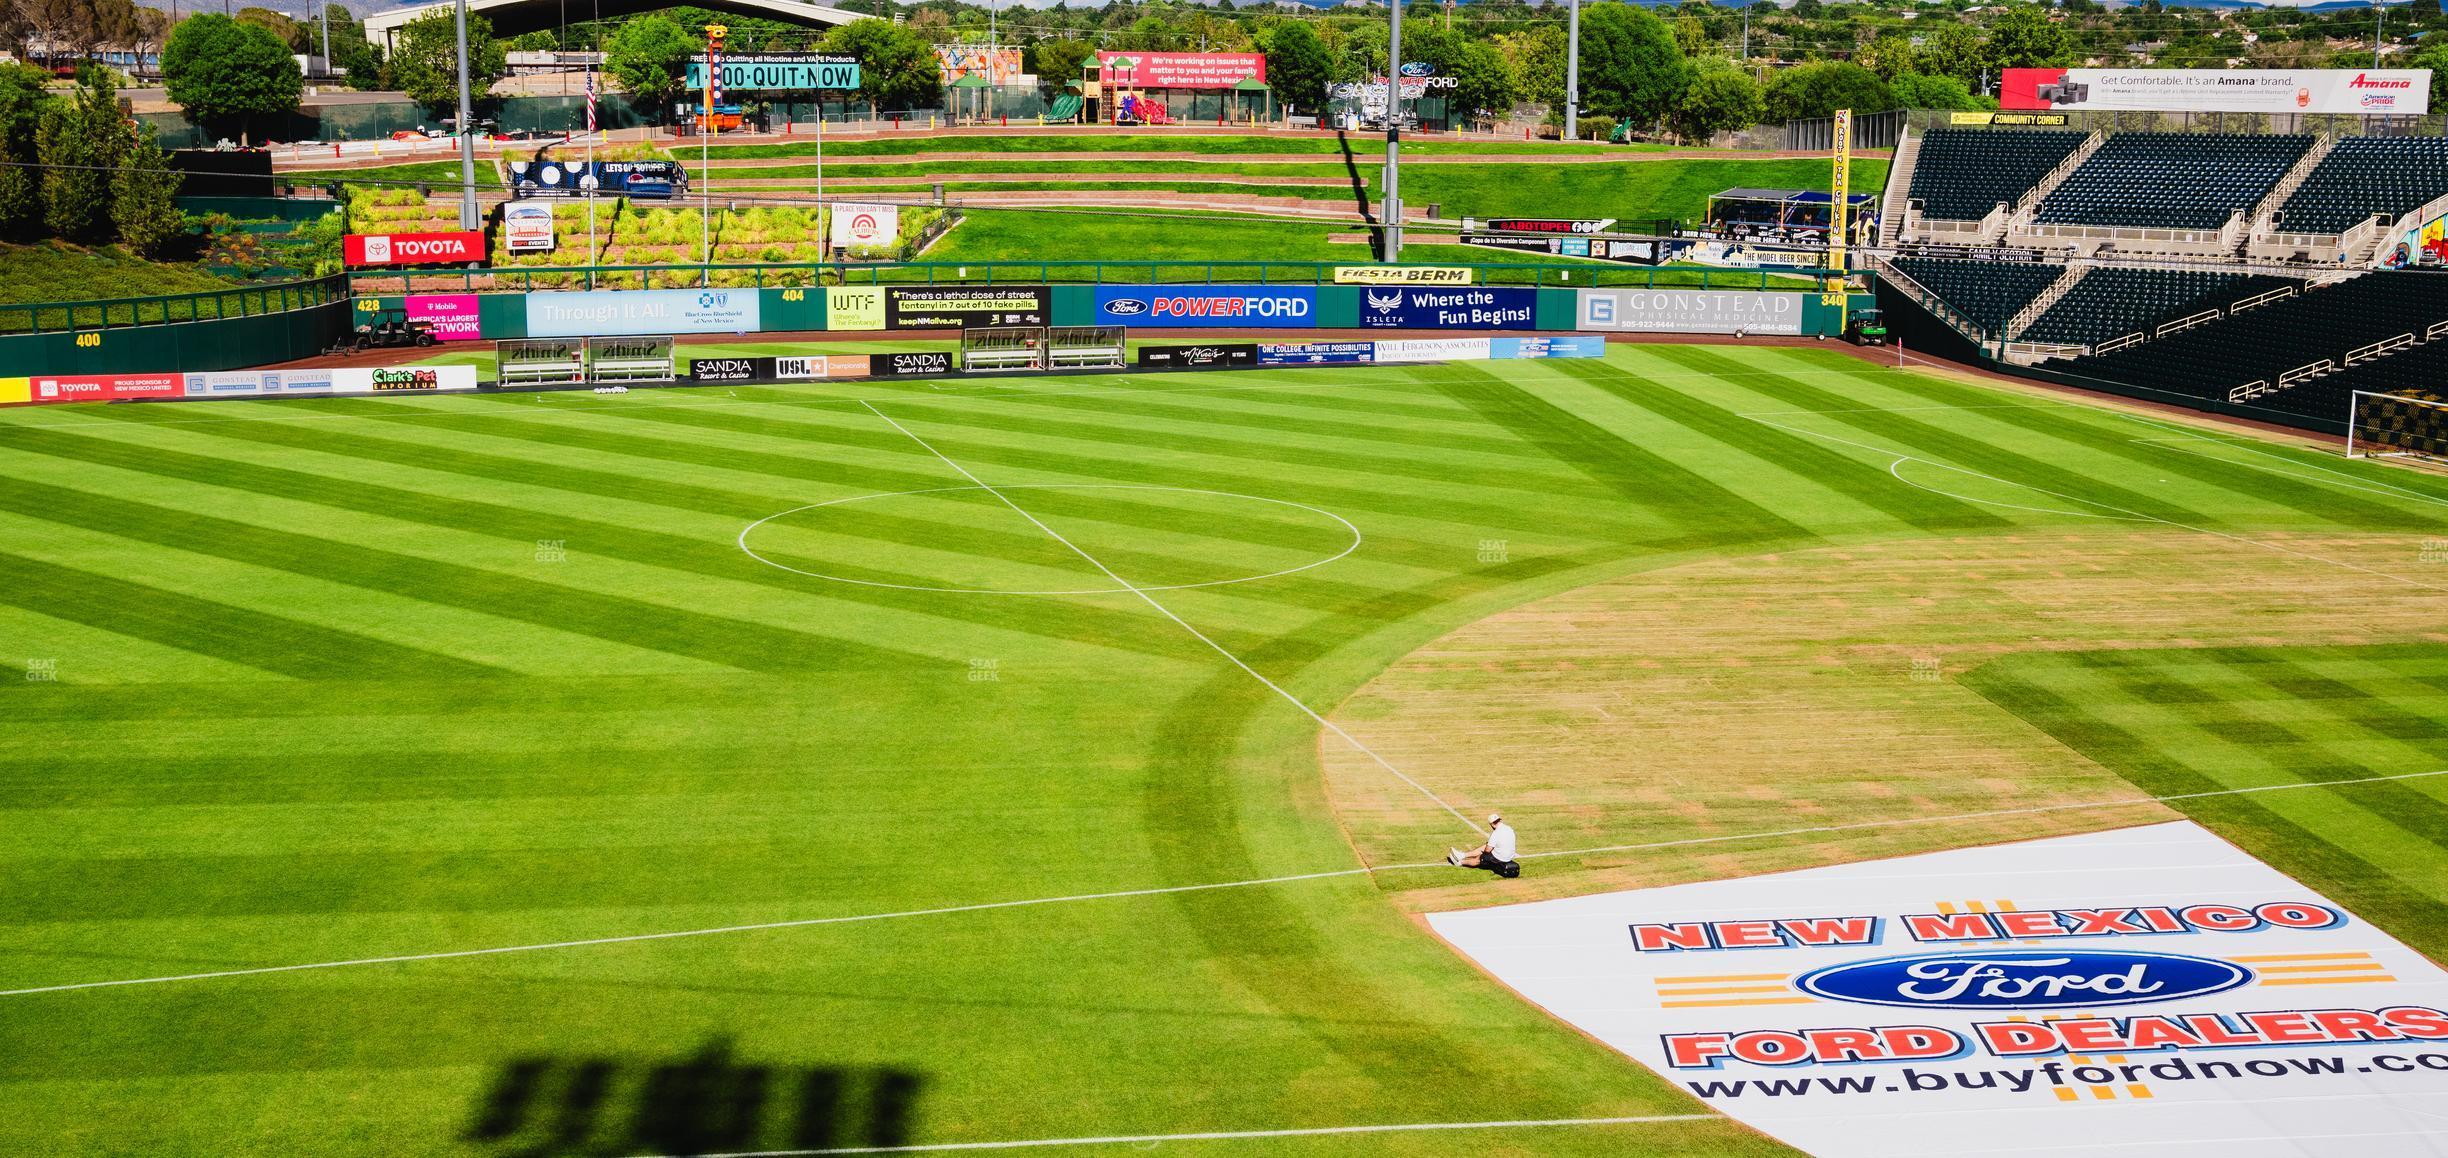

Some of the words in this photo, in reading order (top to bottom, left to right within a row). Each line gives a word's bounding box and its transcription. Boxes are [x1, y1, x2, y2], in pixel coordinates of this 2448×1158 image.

[1152, 57, 1173, 65] We're
[1175, 57, 1205, 66] working
[1217, 57, 1239, 65] issues
[1240, 57, 1256, 65] that
[1234, 67, 1258, 76] family
[1158, 75, 1177, 84] right
[1204, 76, 1220, 84] New
[2101, 76, 2117, 85] Get
[2120, 76, 2183, 86] Comfortable.
[2186, 76, 2201, 85] It's
[2218, 77, 2255, 86] Amana
[2261, 76, 2294, 86] brand.
[2349, 73, 2411, 88] Amana
[1994, 114, 2036, 124] COMMUNITY
[2036, 115, 2065, 125] CORNER
[605, 163, 623, 173] LETS
[1682, 230, 1699, 238] BEER
[1700, 231, 1717, 239] HERE
[1744, 235, 1762, 243] BEER
[395, 240, 466, 256] TOYOTA
[1743, 252, 1756, 261] THE
[1757, 252, 1777, 262] MODEL
[1779, 253, 1795, 263] BEER
[1796, 253, 1815, 263] SINCE
[1342, 269, 1403, 278] FIESTA
[1406, 270, 1465, 281] BERM
[782, 290, 804, 301] 404
[944, 291, 970, 299] lethal
[971, 291, 996, 299] dose
[996, 290, 1006, 299] of
[1007, 291, 1035, 299] street
[1412, 293, 1464, 308] Where
[1467, 291, 1494, 305] the
[1821, 294, 1844, 306] 340
[357, 300, 380, 311] 428
[833, 294, 875, 311] WTF
[901, 301, 938, 310] fentanyl
[939, 301, 947, 309] in
[971, 301, 981, 309] of
[1015, 301, 1036, 310] pills.
[1112, 301, 1139, 314] Ford
[1630, 293, 1790, 313] GONSTEAD
[543, 303, 618, 323] Through
[624, 303, 637, 318] It
[641, 301, 670, 318] All.
[1439, 310, 1468, 325] Fun
[1471, 306, 1531, 325] Begins!
[1639, 312, 1705, 320] PHYSICAL
[1713, 313, 1780, 322] MEDICINE
[447, 314, 479, 322] LARGEST
[898, 317, 963, 326] keepNMalive.org
[77, 333, 101, 347] 400
[1262, 345, 1275, 353] ONE
[1276, 344, 1304, 353] COLLEGE,
[1304, 344, 1330, 352] INFINITE
[1331, 343, 1371, 351] POSSIBILITIES
[1376, 342, 1400, 352] WILL
[1402, 341, 1441, 352] FERGUSON
[1445, 340, 1489, 350] ASSOCIATES
[828, 361, 869, 370] Championship
[893, 354, 948, 367] SANDIA
[695, 360, 753, 373] SANDIA
[897, 366, 918, 374] Resort
[925, 365, 945, 373] Casino
[212, 376, 257, 384] GONSTEAD
[287, 374, 331, 382] GONSTEAD
[373, 369, 414, 383] Clark's
[415, 370, 437, 382] Pet
[728, 371, 751, 379] Casino
[60, 383, 102, 392] TOYOTA
[373, 382, 437, 390] EMPORIUM
[1628, 915, 1877, 952] NEW
[1901, 900, 2343, 942] MEXICO
[1897, 957, 2165, 1000] Ford
[1660, 1024, 1966, 1069] FORD
[1971, 1004, 2448, 1057] DEALERS
